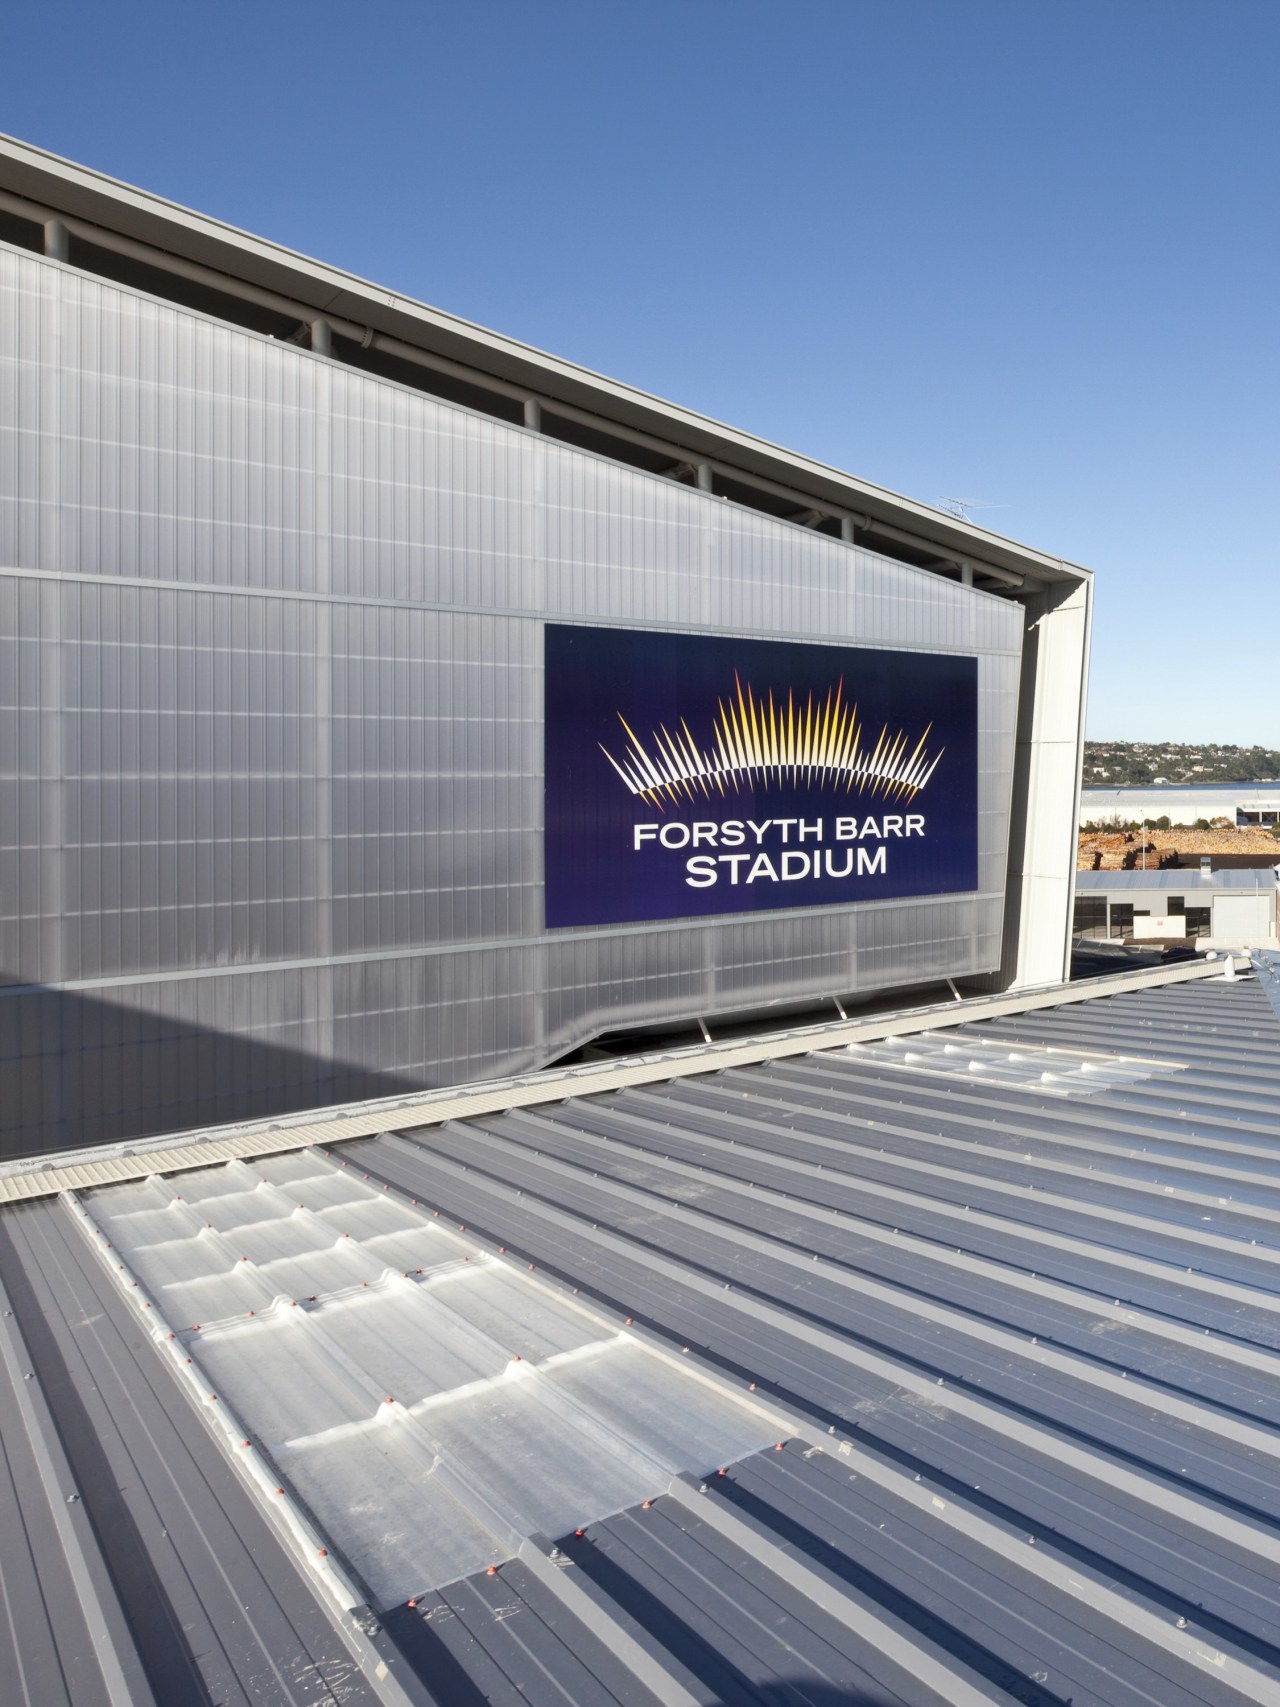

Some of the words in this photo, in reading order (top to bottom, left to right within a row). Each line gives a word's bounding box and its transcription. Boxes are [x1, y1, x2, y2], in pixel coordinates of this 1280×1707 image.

[634, 818, 823, 850] FORSYTH
[836, 815, 925, 840] BARR
[685, 846, 887, 888] STADIUM
